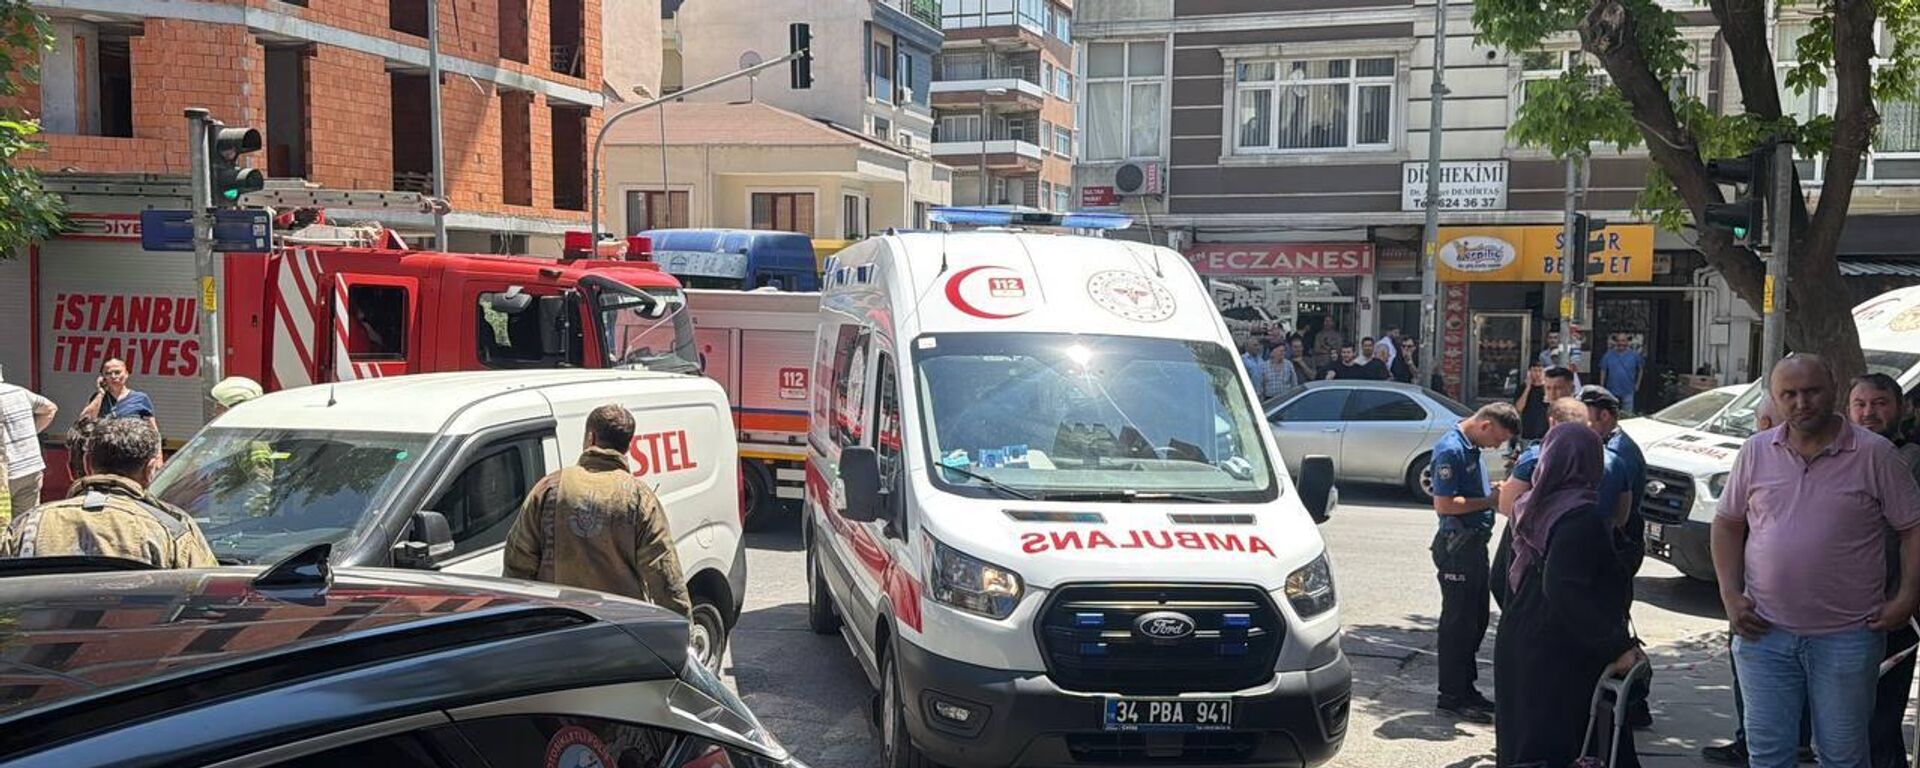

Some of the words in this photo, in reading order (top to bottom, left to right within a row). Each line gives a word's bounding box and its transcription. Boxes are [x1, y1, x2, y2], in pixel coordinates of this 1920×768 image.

[1408, 164, 1429, 183] Dİ
[1439, 163, 1503, 183] HEKİMİ
[1463, 199, 1478, 208] 36
[1481, 199, 1496, 208] 37
[1209, 246, 1370, 269] ECZANESİ
[994, 279, 1019, 290] 112
[54, 336, 202, 377] İTFAİYES
[784, 372, 804, 387] 112
[630, 430, 698, 477] STEL
[1151, 620, 1184, 634] Ford
[1117, 701, 1139, 722] 34
[1150, 702, 1183, 722] PBA
[1197, 702, 1227, 722] 941
